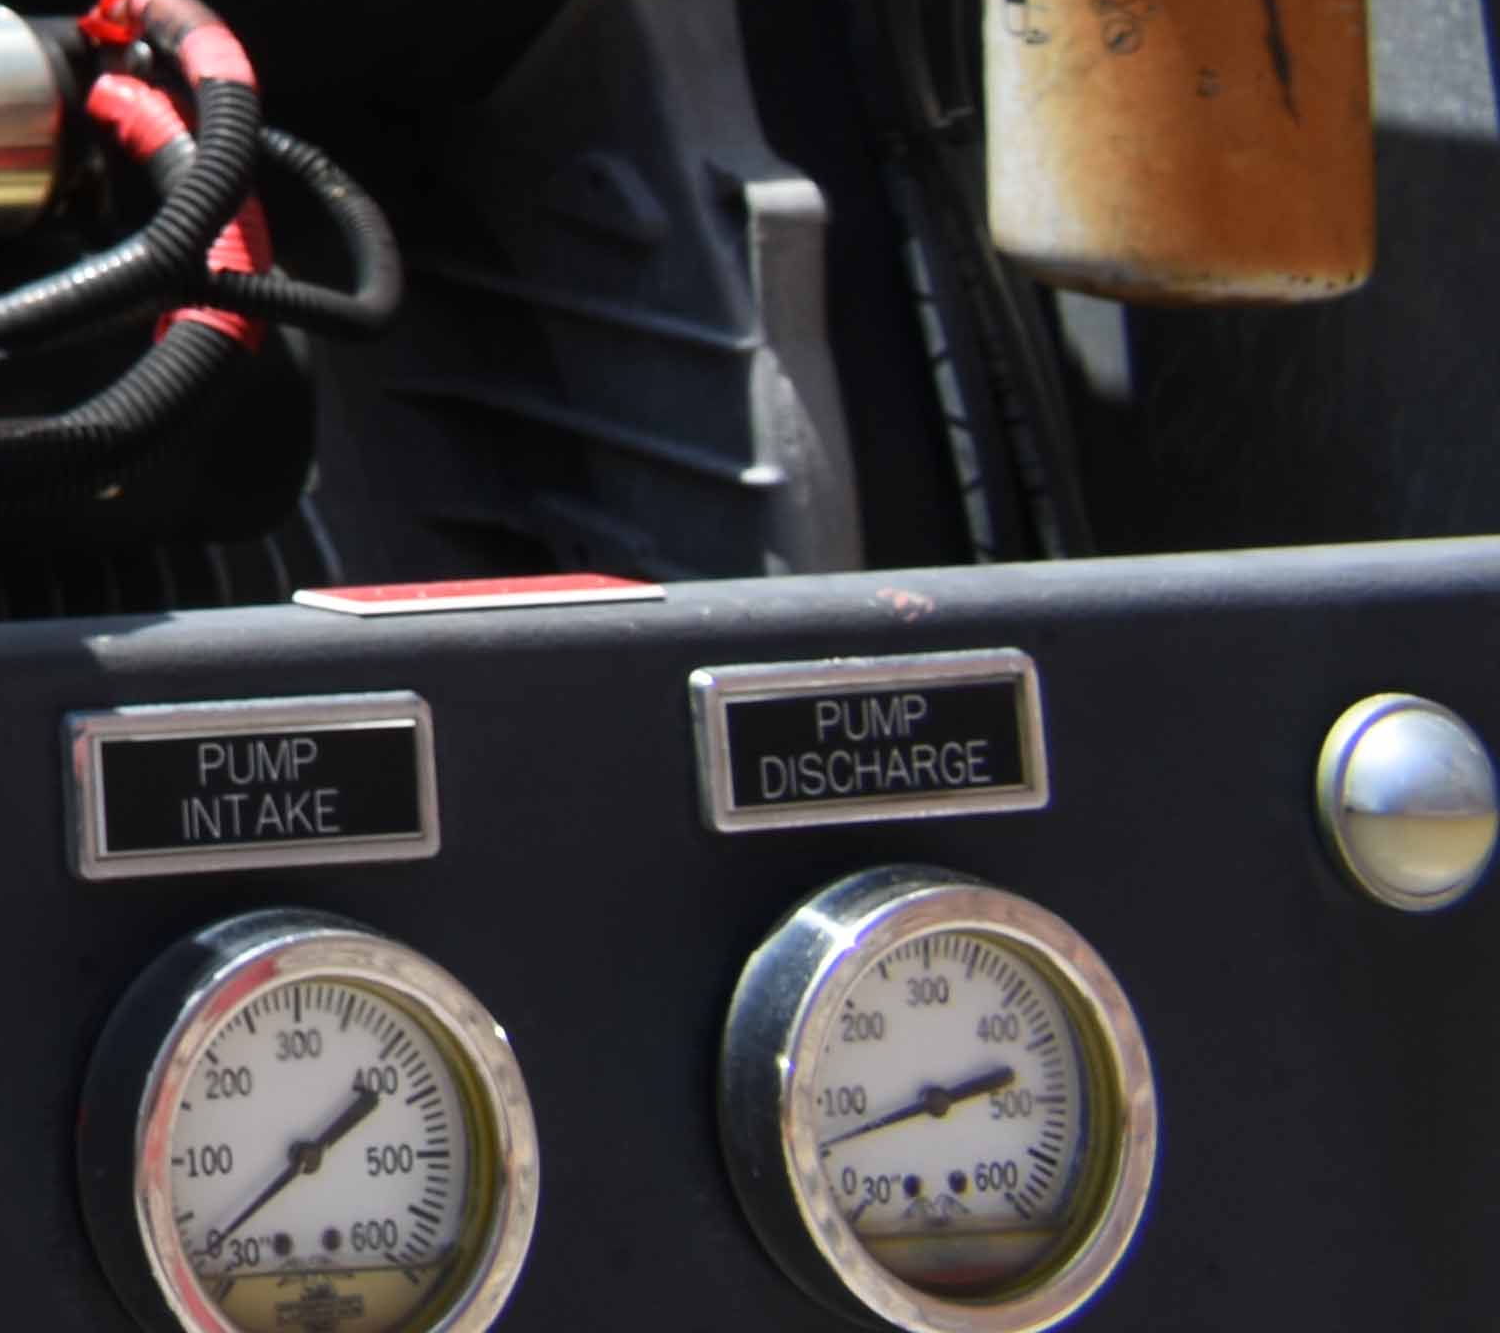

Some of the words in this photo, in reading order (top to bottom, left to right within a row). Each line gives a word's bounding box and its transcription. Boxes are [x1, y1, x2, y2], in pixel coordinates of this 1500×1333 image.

[815, 693, 929, 742] PUMP
[198, 737, 320, 787] PUMP
[759, 738, 992, 800] DISCHARGE
[181, 788, 342, 841] INTAKE
[906, 976, 949, 1006] 300
[841, 1012, 884, 1041] 200
[977, 1014, 1019, 1043] 400
[275, 1029, 322, 1061] 300
[206, 1067, 252, 1099] 200
[352, 1065, 398, 1096] 400
[824, 1085, 867, 1115] 100
[989, 1089, 1033, 1120] 500
[185, 1145, 233, 1177] 100
[366, 1144, 413, 1176] 500
[974, 1161, 1018, 1191] 600
[842, 1166, 857, 1196] 0
[350, 1218, 398, 1251] 600
